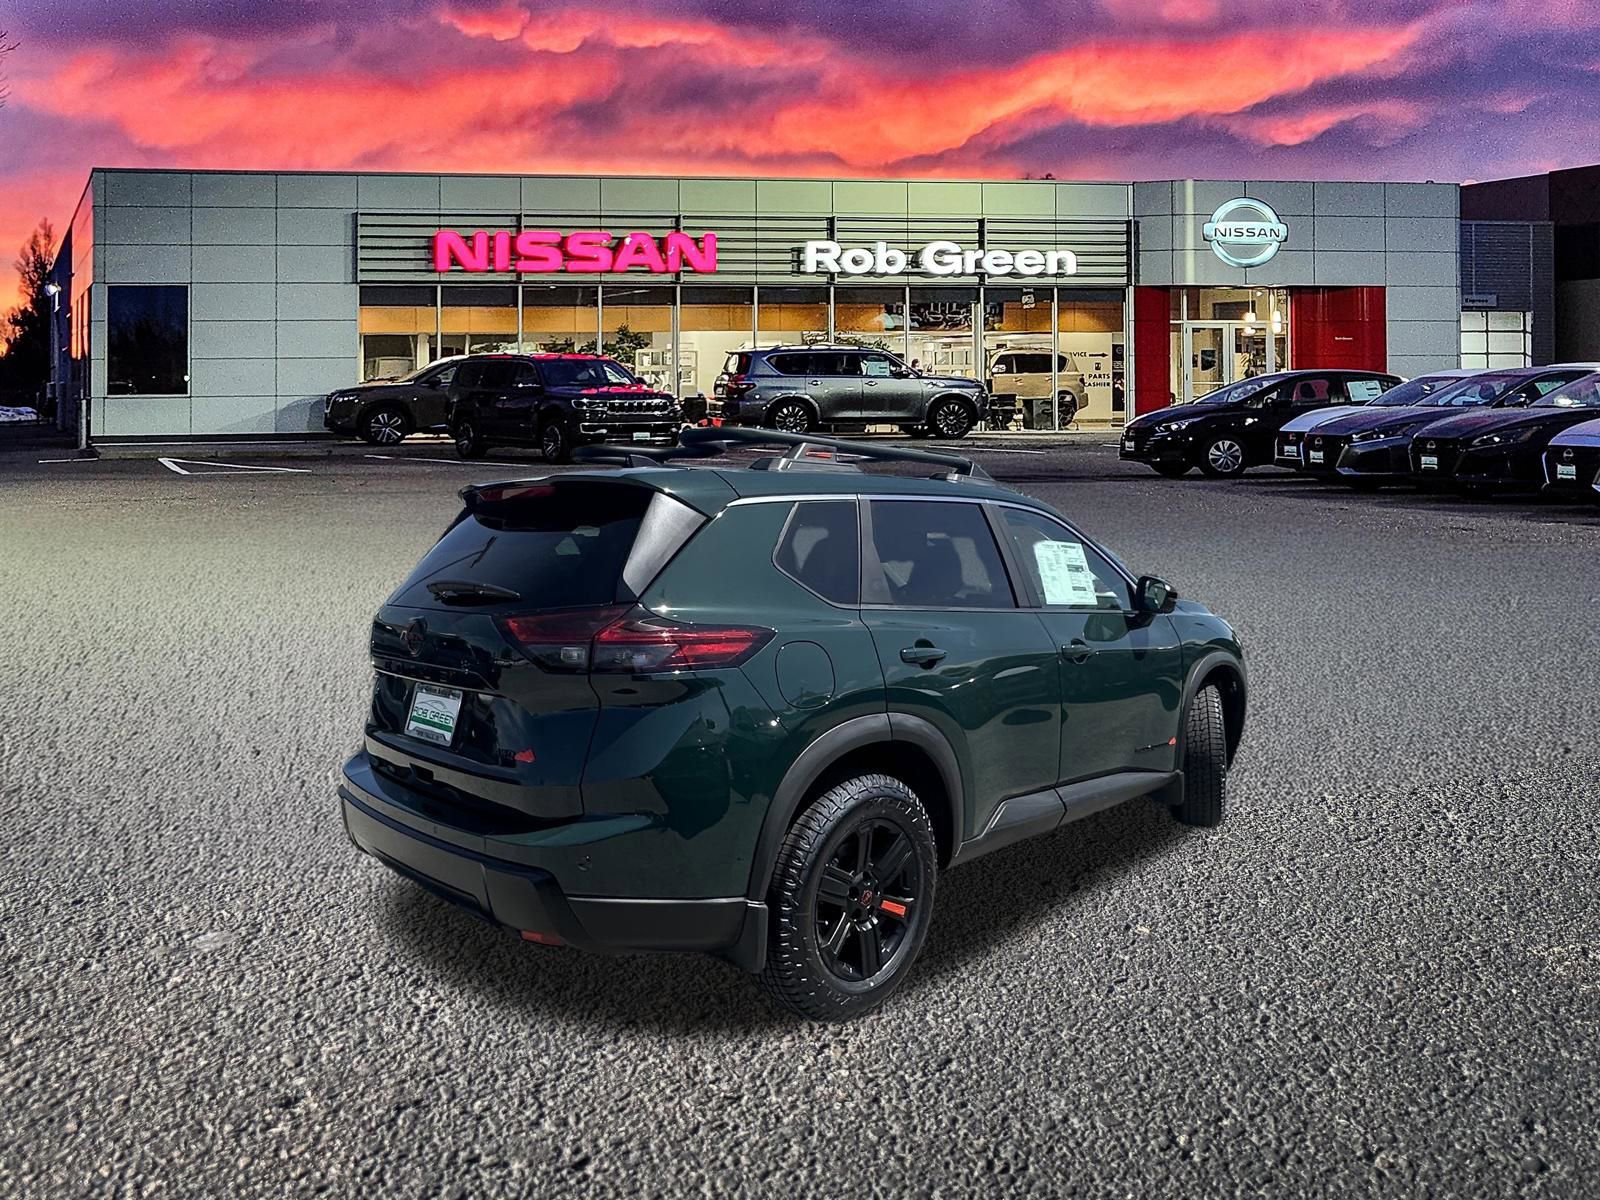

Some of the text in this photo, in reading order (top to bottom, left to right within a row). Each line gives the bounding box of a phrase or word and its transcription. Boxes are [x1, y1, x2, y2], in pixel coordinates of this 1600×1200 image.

[1214, 227, 1280, 238] NISSAN
[433, 230, 718, 273] NISSAN
[804, 240, 1078, 275] Rob Green
